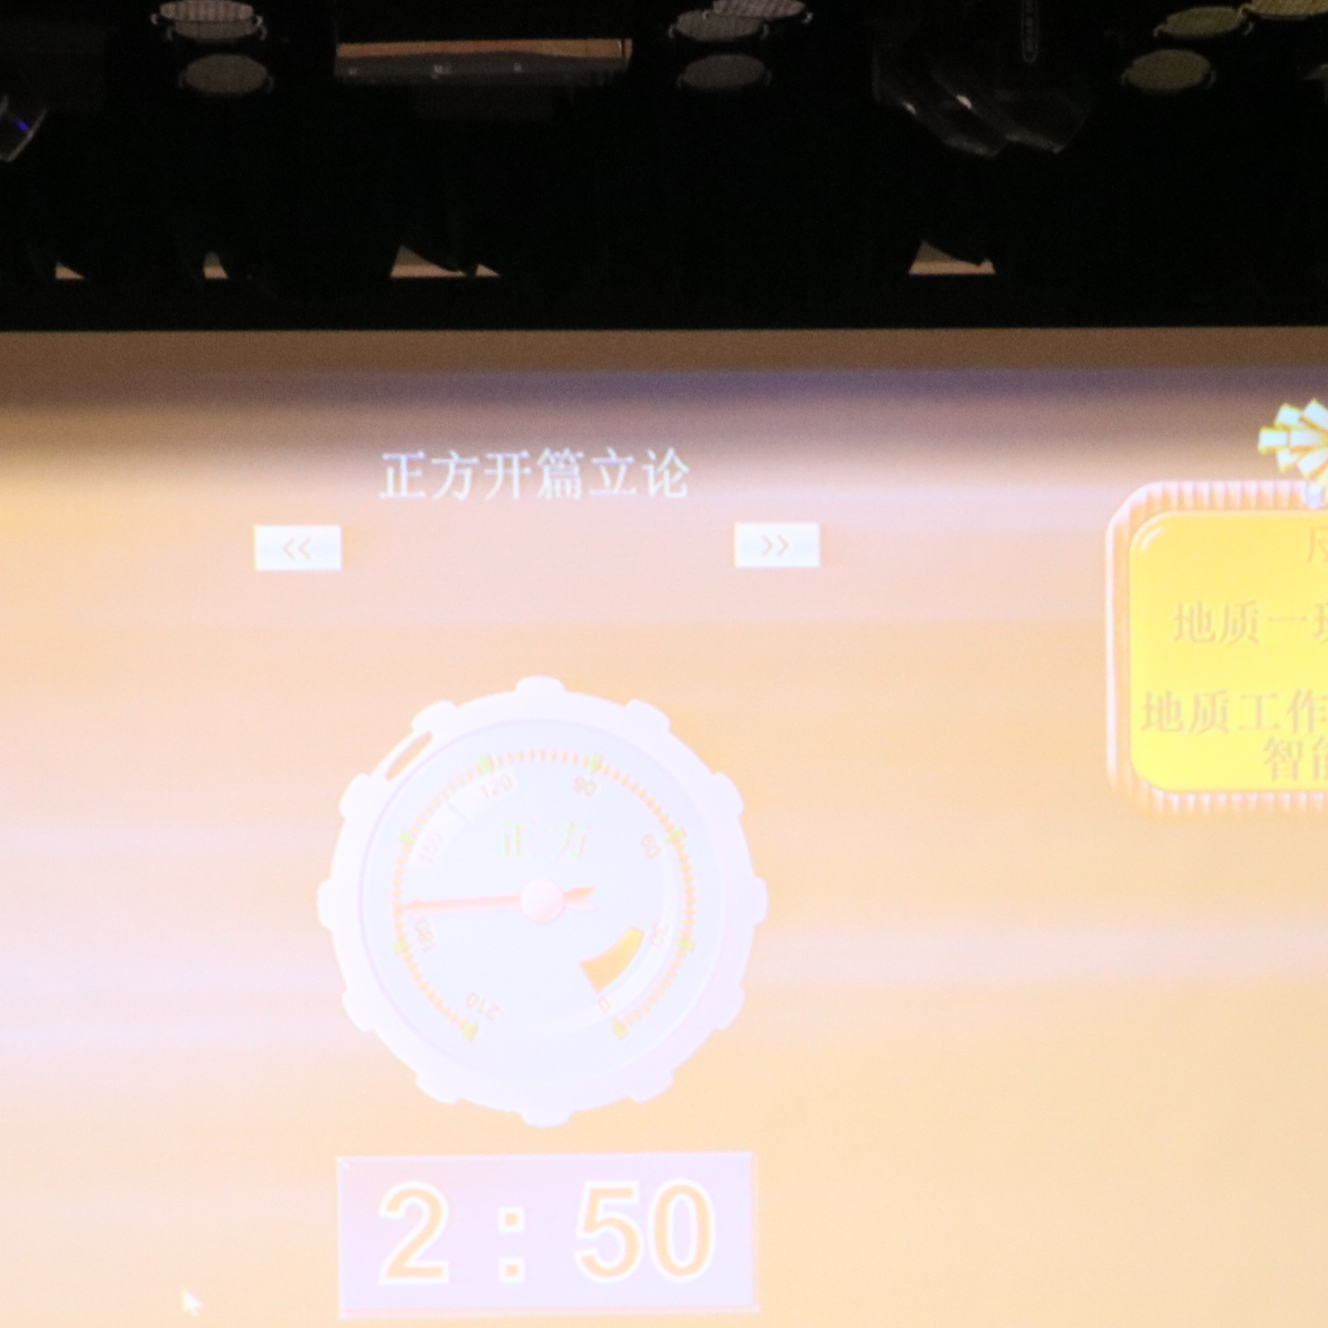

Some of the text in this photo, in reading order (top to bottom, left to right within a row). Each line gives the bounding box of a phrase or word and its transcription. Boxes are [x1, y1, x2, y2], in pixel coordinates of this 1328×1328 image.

[378, 448, 692, 501] 正方开篇立论
